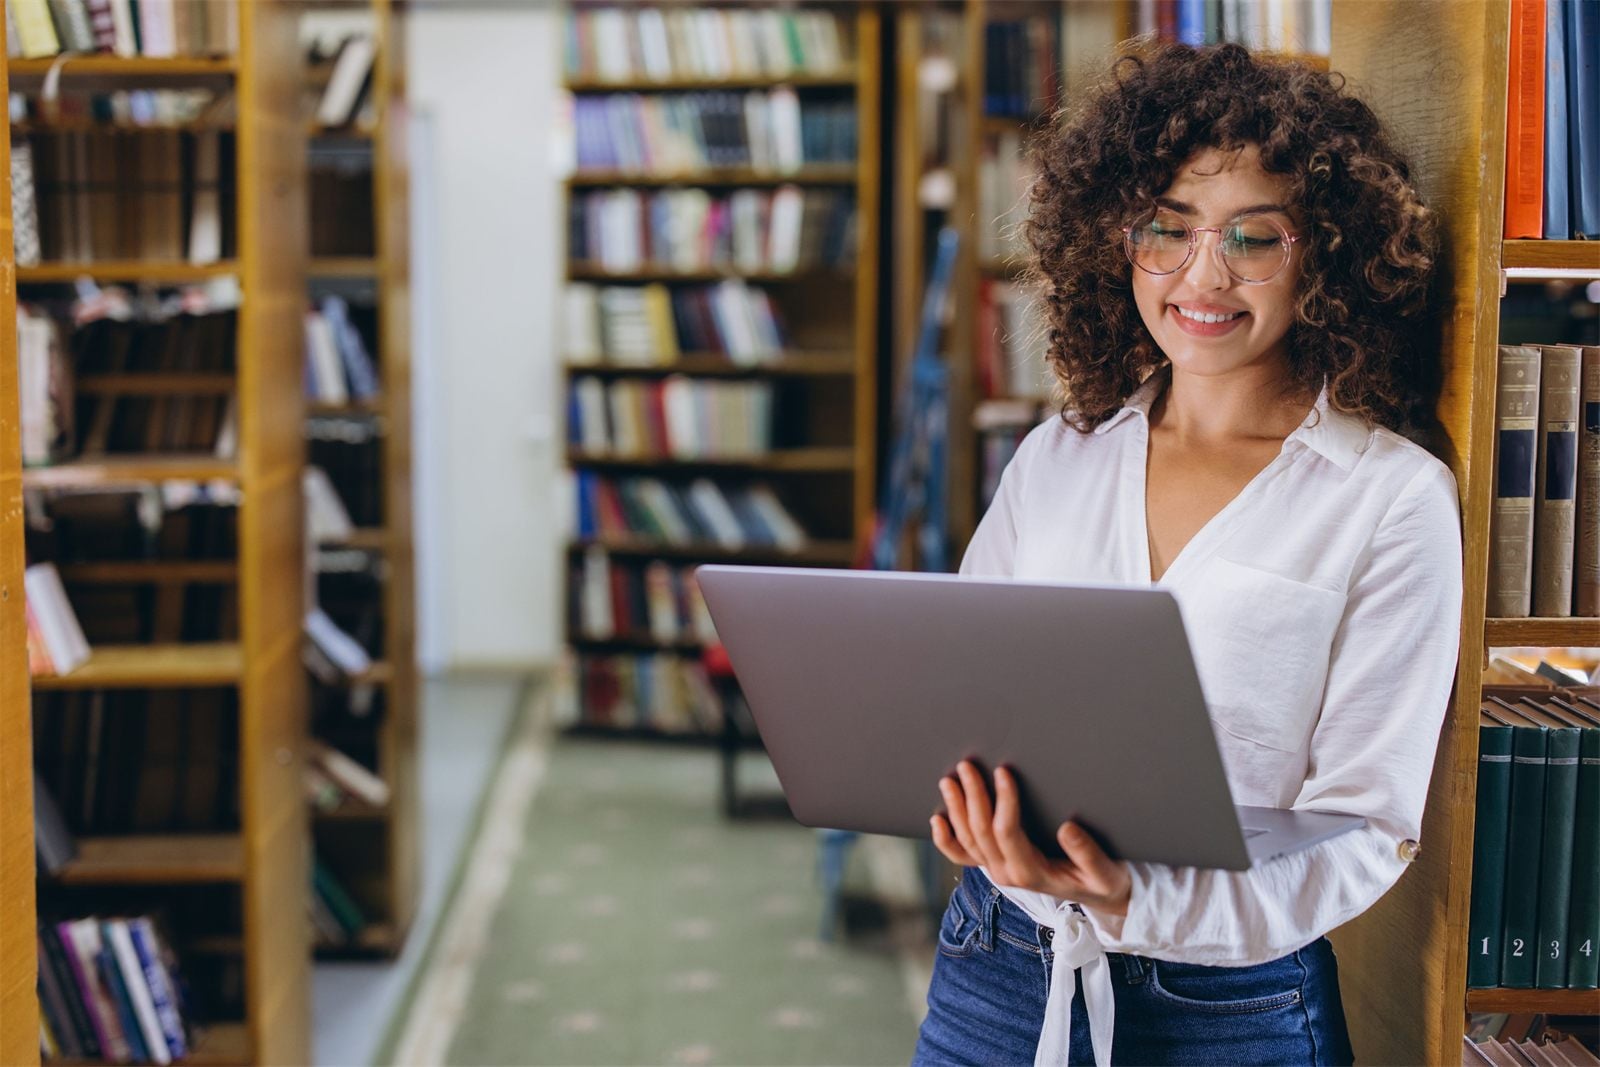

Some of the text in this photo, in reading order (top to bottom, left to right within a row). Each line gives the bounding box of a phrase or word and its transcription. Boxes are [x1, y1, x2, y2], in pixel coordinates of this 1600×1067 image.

[1480, 937, 1490, 955] 1
[1512, 938, 1524, 957] 2
[1550, 940, 1560, 959] 3
[1579, 939, 1592, 957] 4
